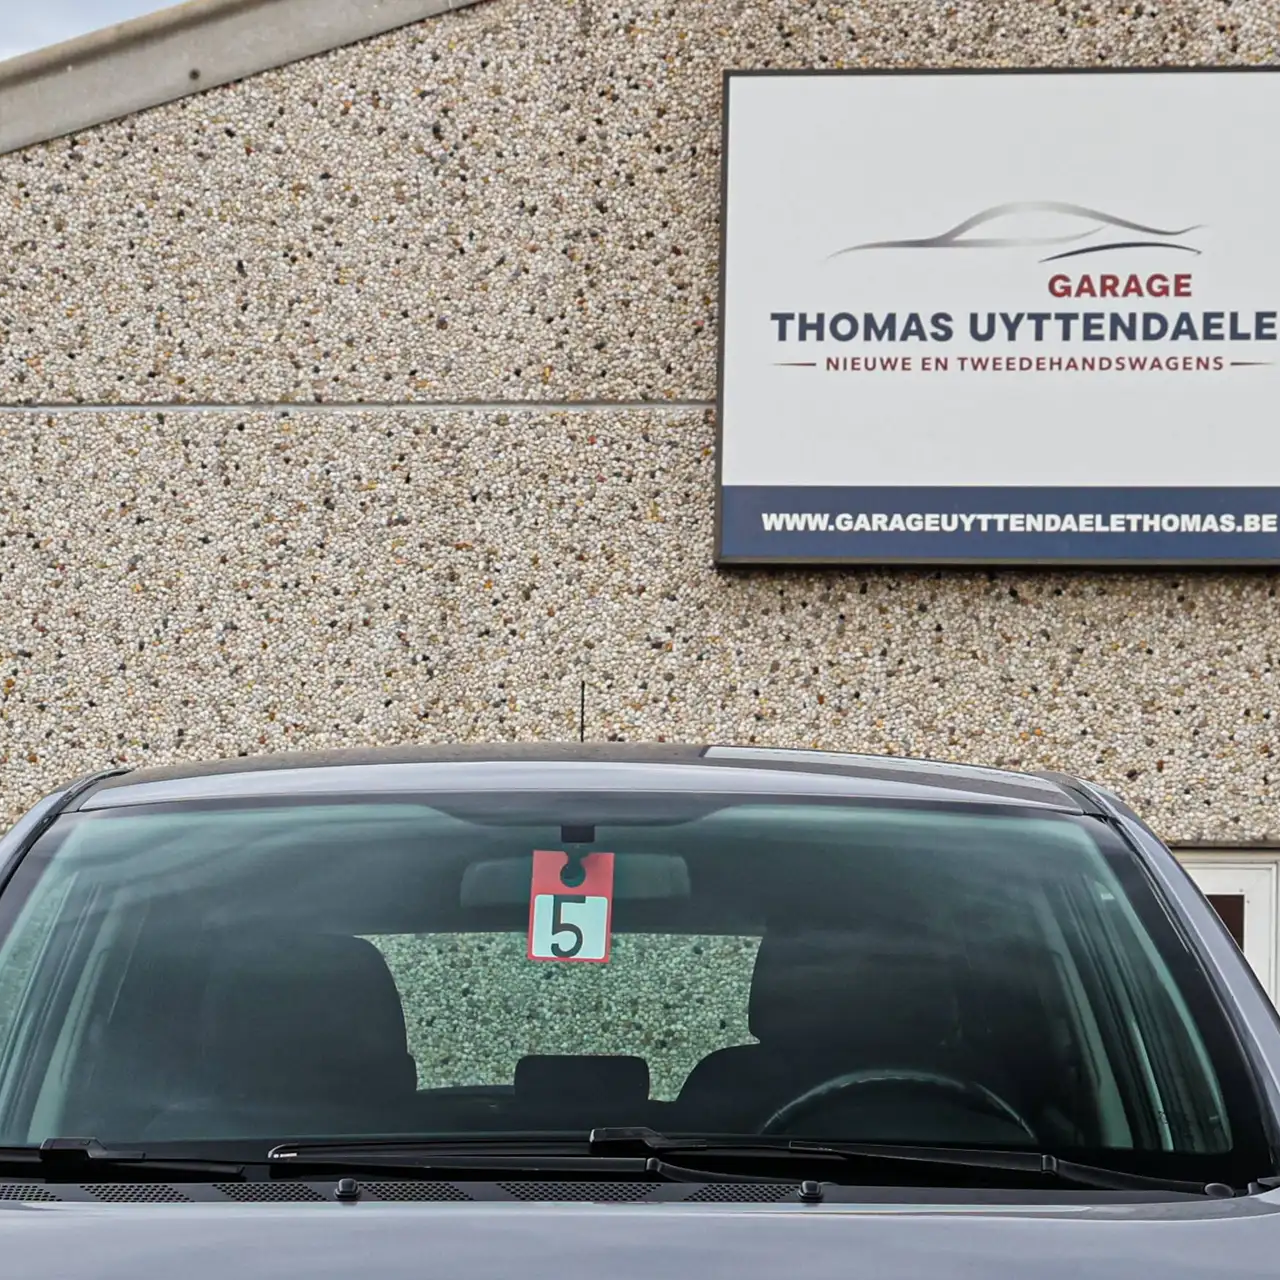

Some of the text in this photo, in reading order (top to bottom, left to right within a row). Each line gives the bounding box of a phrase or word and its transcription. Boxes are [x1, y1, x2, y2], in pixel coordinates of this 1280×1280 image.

[1047, 273, 1193, 298] GARAGE
[770, 311, 1278, 342] THOMAS UYTTENDAELE
[826, 355, 1225, 372] NIEUWE EN TWEEDEHANDSWAGENS
[761, 512, 1278, 534] WWW.GARAGEUYTTENDAELETHOMAS.BE
[551, 894, 586, 958] 5
